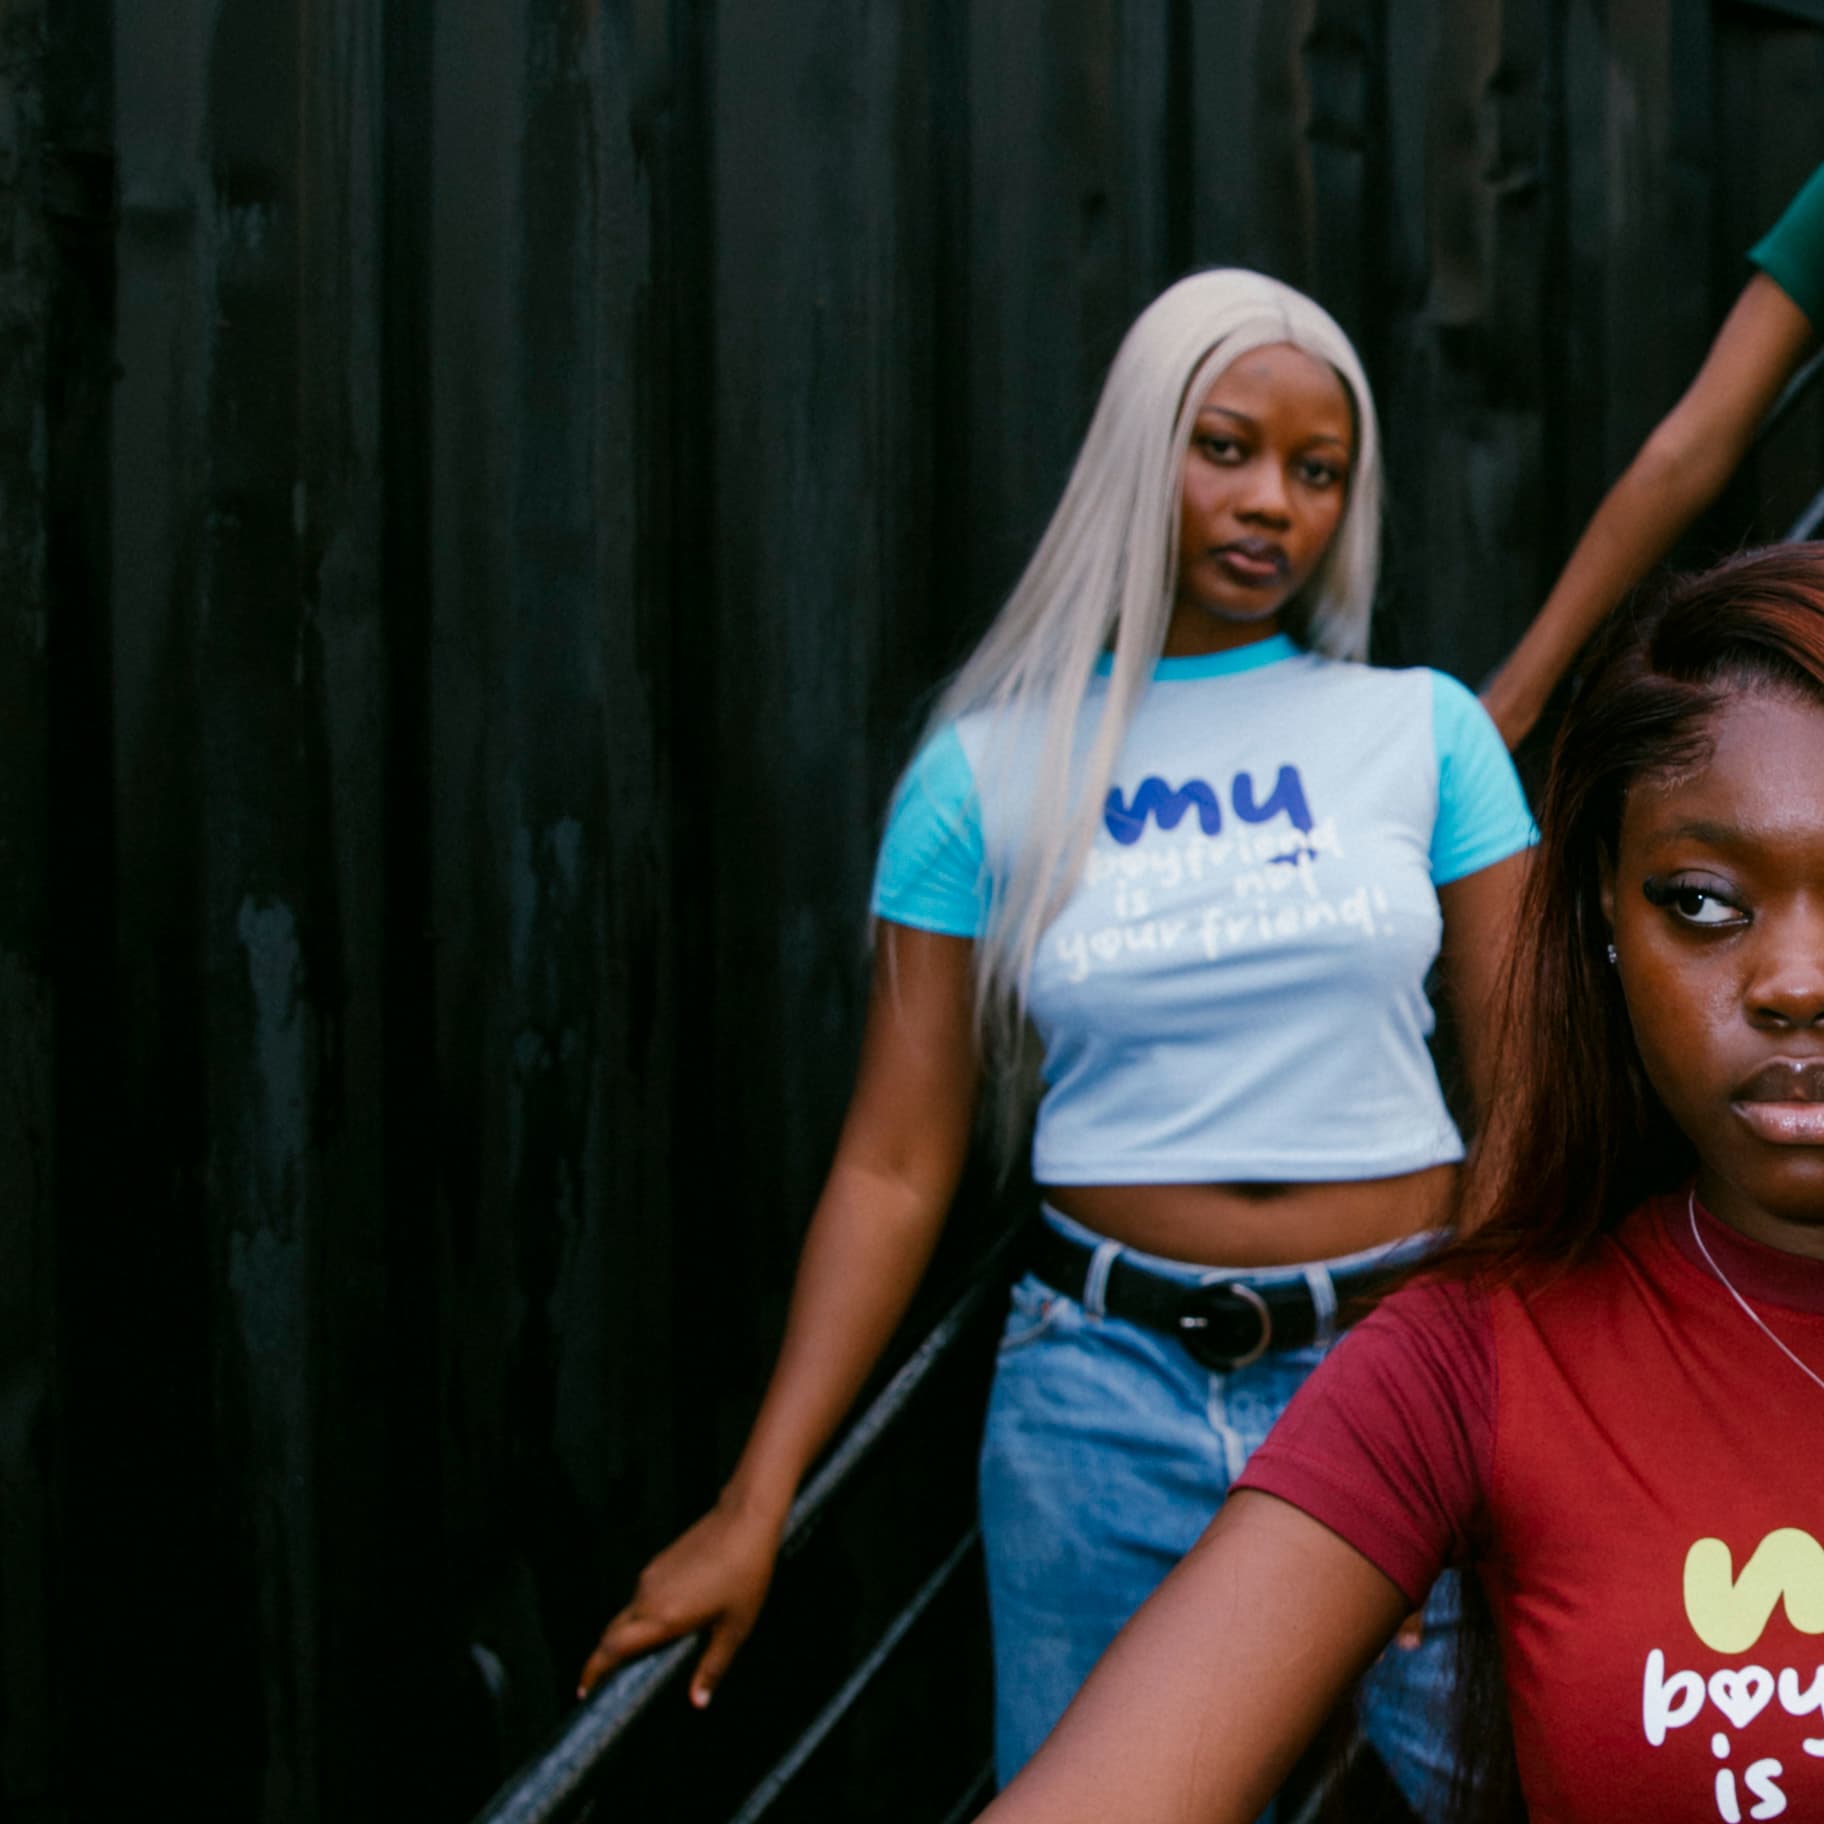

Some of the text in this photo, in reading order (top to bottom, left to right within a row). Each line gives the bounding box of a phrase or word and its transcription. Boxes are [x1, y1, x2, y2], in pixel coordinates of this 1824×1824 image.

[1105, 763, 1317, 865] my
[1114, 852, 1319, 918] is not
[1056, 885, 1395, 984] your friend!
[1711, 1732, 1787, 1824] is
